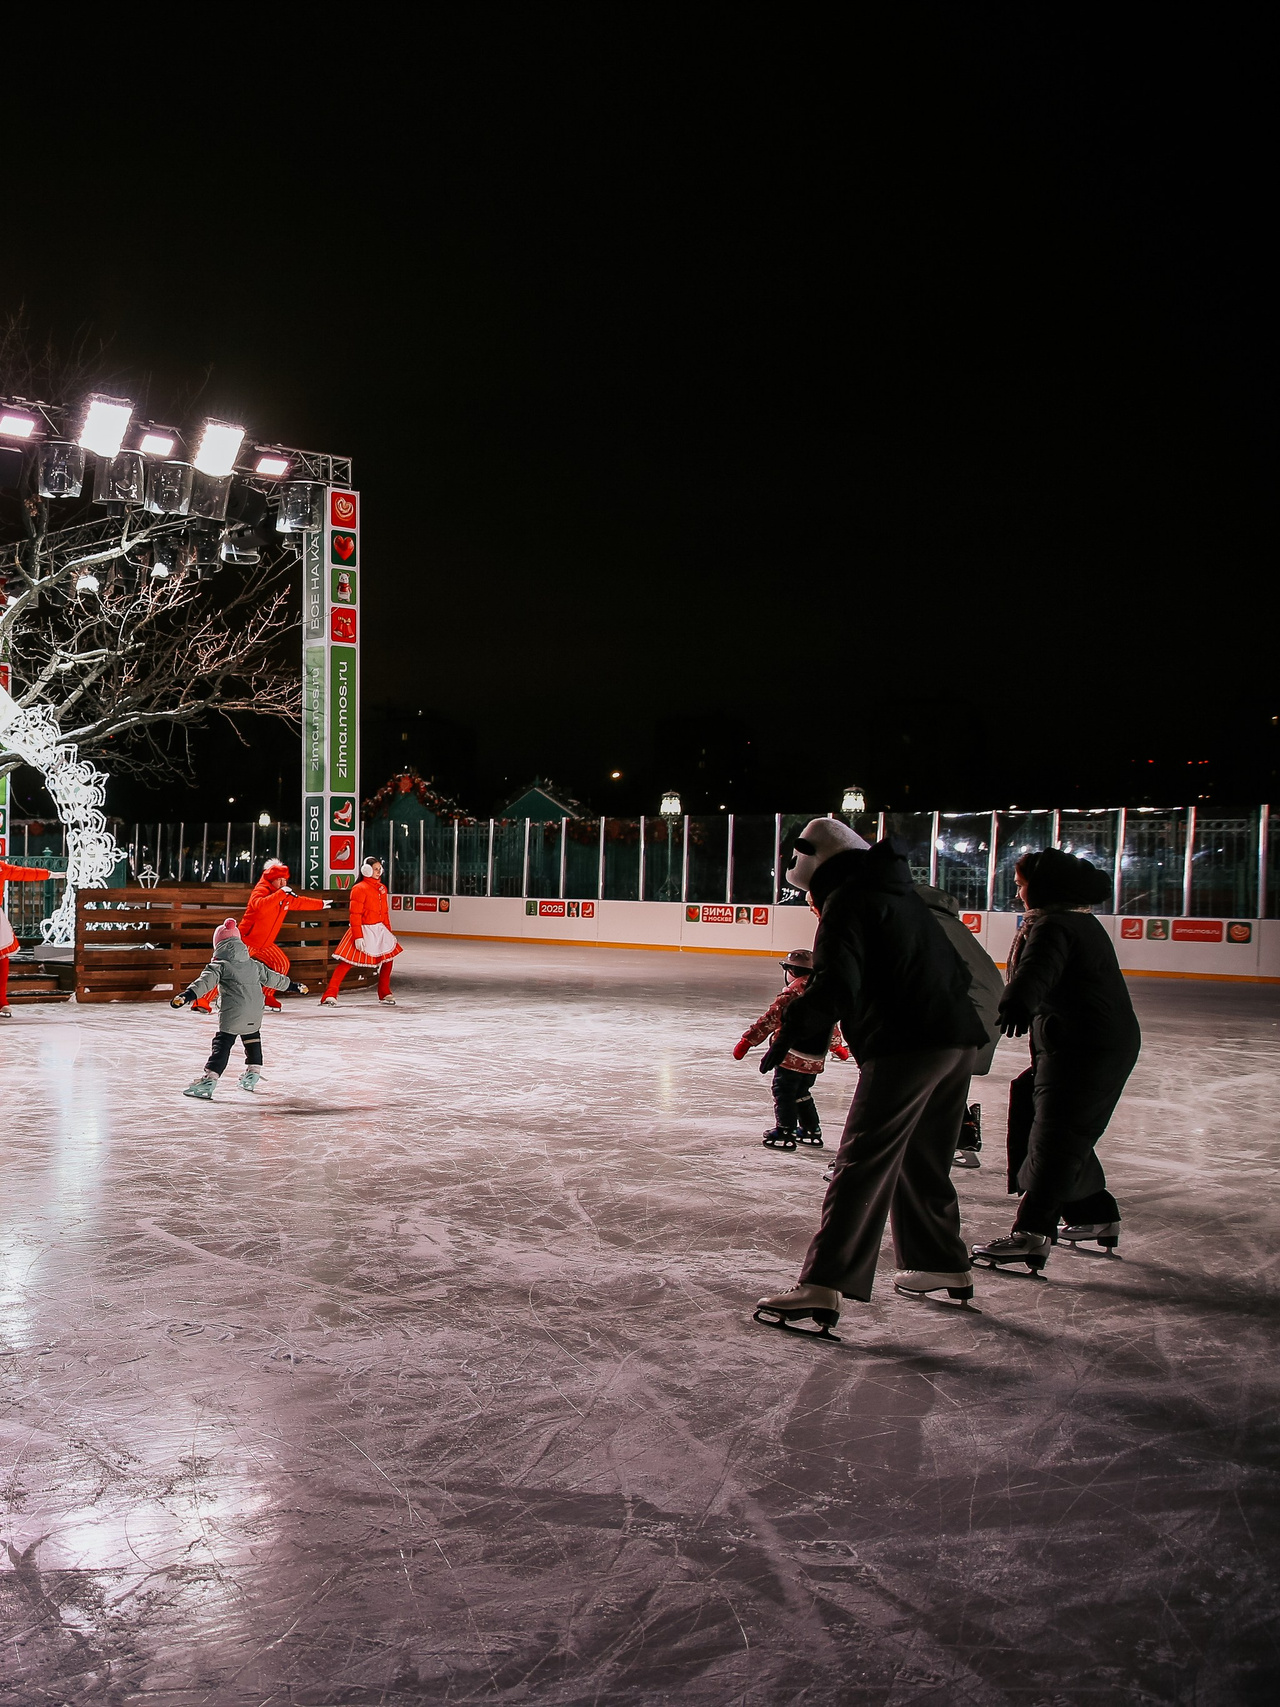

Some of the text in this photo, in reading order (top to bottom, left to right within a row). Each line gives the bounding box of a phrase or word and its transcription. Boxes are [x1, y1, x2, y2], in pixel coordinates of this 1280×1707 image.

[310, 565, 320, 589] НА
[310, 594, 320, 629] ВСЕ
[309, 667, 320, 772] zima.mos.ru
[336, 661, 350, 779] zima.mos.ru
[310, 805, 320, 842] ВСЕ
[310, 846, 320, 872] НА
[541, 905, 563, 913] 2025
[703, 907, 732, 916] ЗИМА
